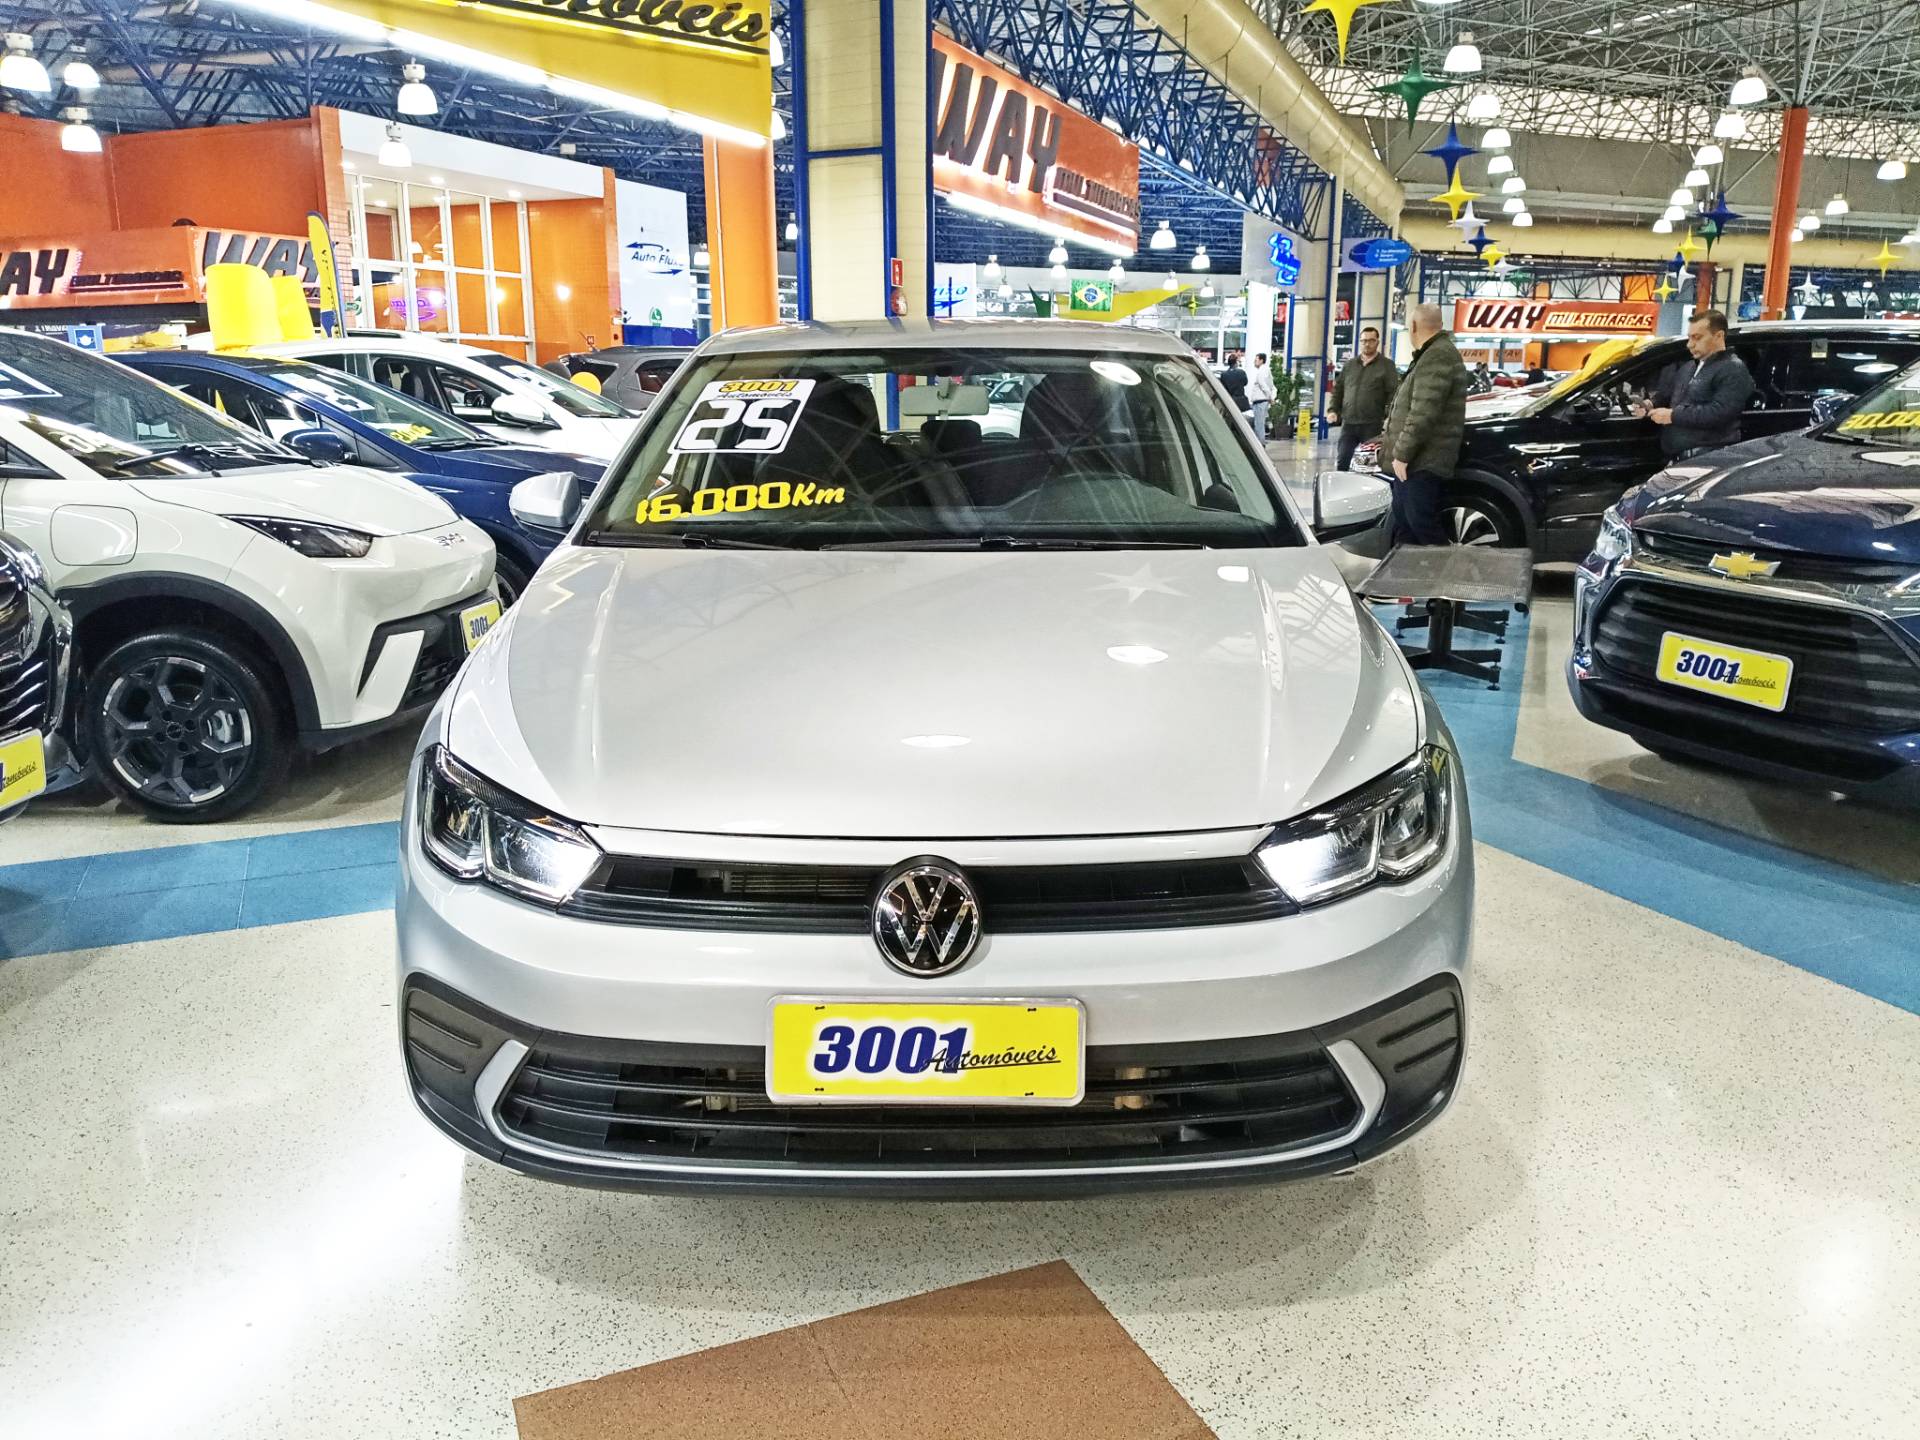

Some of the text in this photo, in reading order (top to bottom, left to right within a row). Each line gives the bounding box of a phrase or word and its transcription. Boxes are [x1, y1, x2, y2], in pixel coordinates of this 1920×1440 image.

[933, 48, 1063, 193] WAY
[0, 249, 70, 296] AY
[631, 251, 684, 267] Auto Flu
[1467, 304, 1654, 329] WAY MULTIMARCAS
[719, 381, 799, 393] 3001
[678, 400, 794, 450] 25
[469, 615, 489, 639] 3001
[1676, 650, 1741, 685] 3001
[812, 1024, 1060, 1074] 3001 Automóveis
